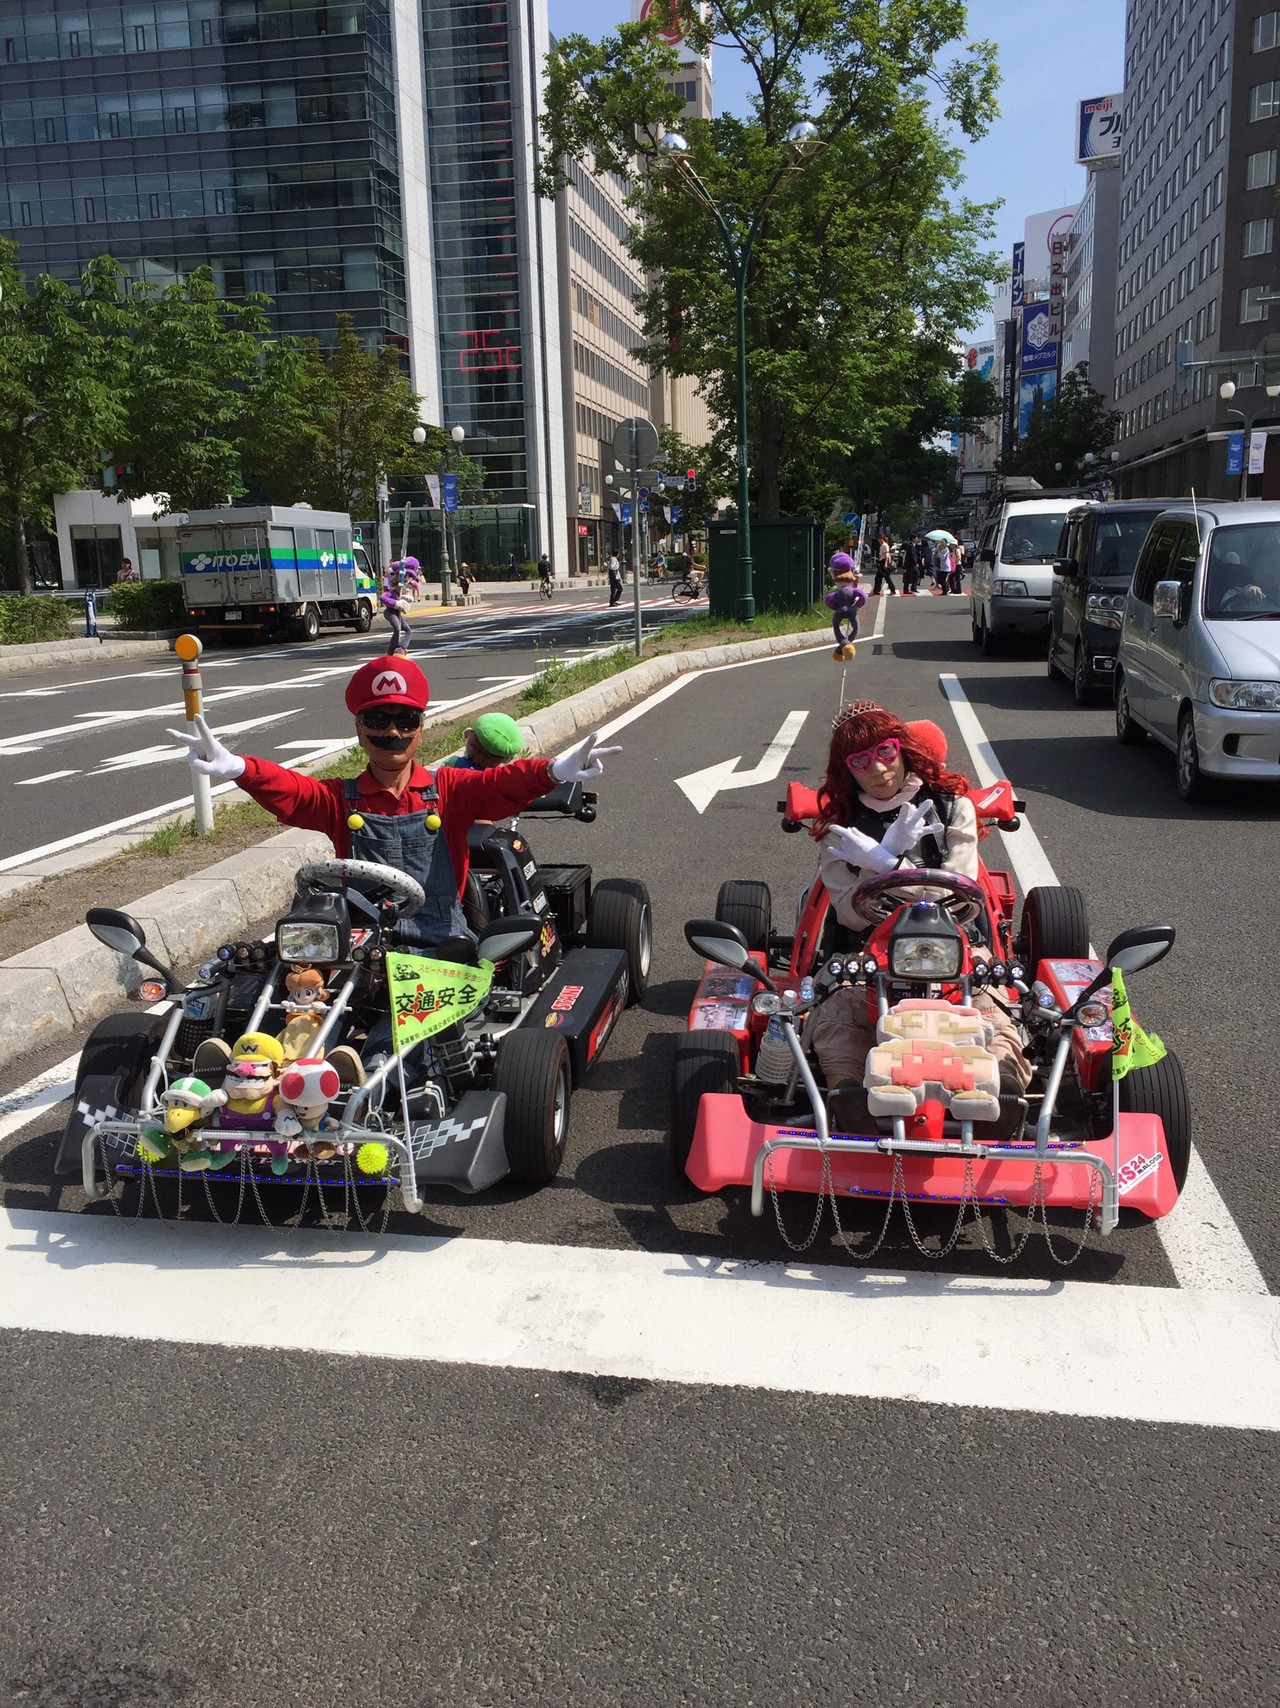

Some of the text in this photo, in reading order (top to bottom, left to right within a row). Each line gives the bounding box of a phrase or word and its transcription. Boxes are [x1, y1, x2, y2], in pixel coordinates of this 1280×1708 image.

[1085, 100, 1113, 113] meiji
[1013, 245, 1024, 305] イーオン
[1049, 241, 1062, 336] 日之出ビル
[376, 676, 401, 691] M
[395, 983, 477, 1013] 交通安全
[241, 1043, 258, 1053] W
